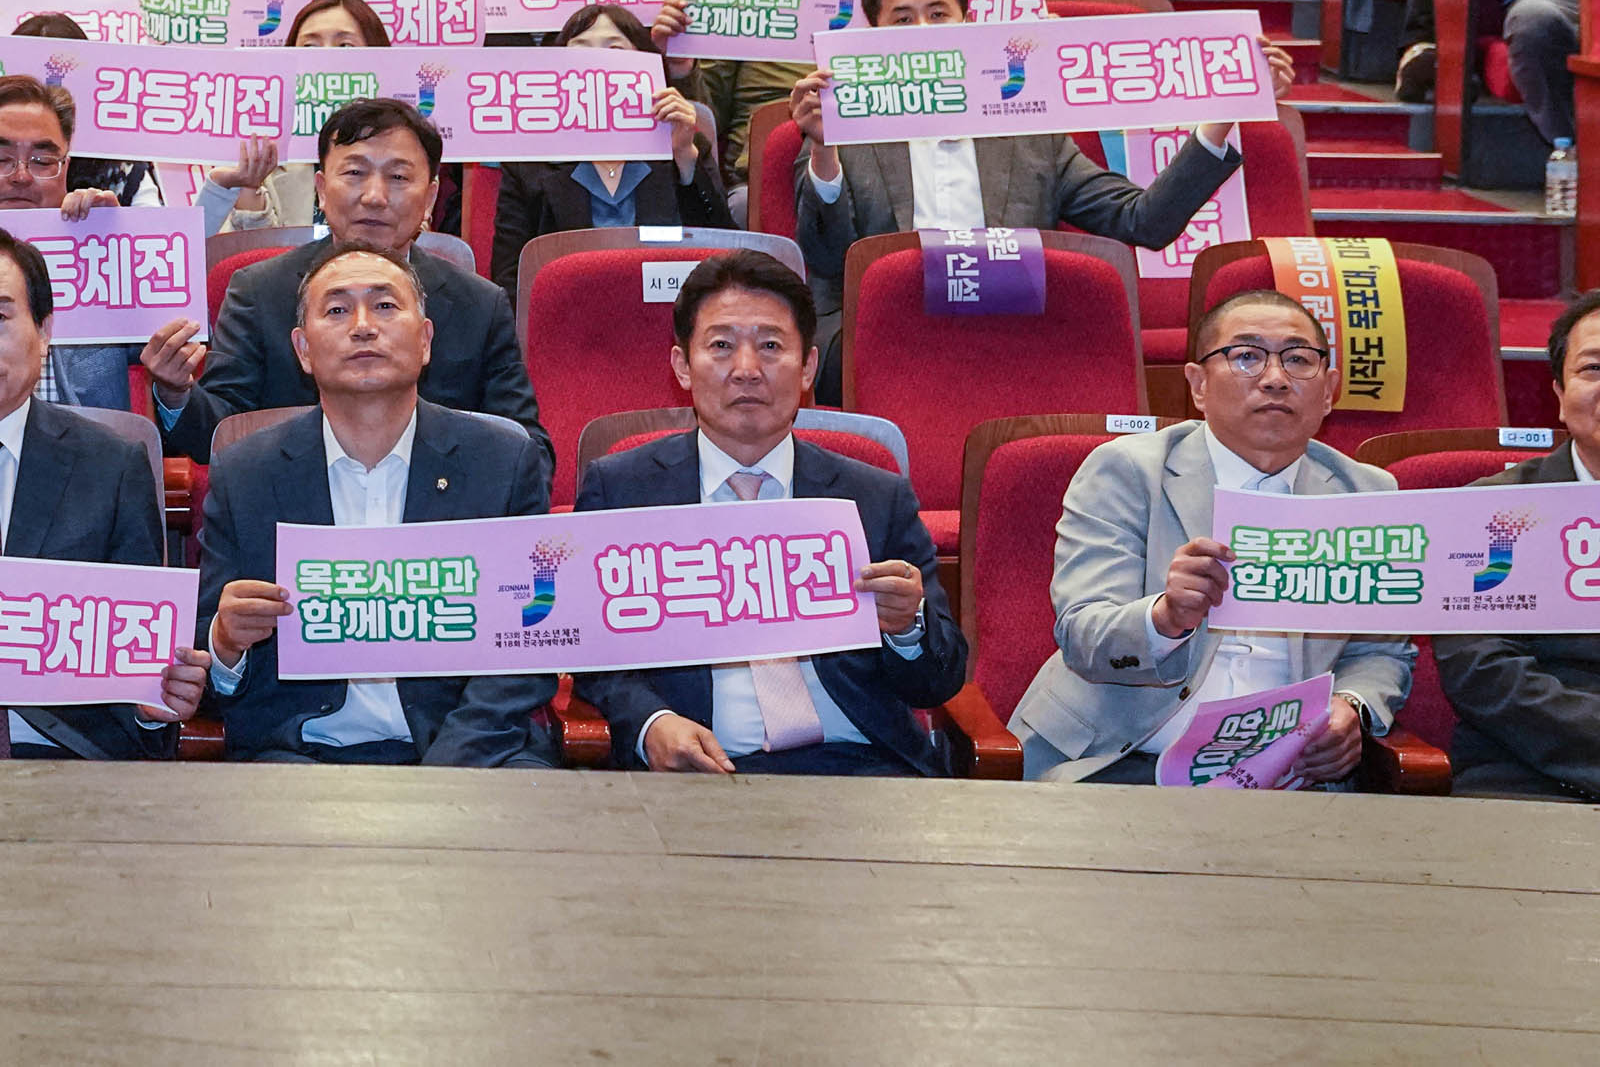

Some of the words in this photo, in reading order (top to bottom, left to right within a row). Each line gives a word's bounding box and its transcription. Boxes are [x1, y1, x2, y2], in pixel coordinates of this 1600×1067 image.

[683, 4, 798, 39] 함께하는
[295, 71, 379, 101] 시민과
[828, 50, 966, 84] 목포시민과
[1057, 34, 1260, 106] 감동체전
[93, 67, 285, 140] 감동체전
[467, 69, 657, 134] 감동체전
[835, 78, 967, 119] 함께하는
[649, 276, 681, 292] 시의
[946, 251, 980, 304] 신설
[1343, 263, 1383, 331] 목포대,
[1346, 335, 1385, 400] 시작도
[1113, 419, 1150, 430] 다-002
[1507, 432, 1547, 443] 다-001
[1230, 523, 1429, 565] 목포시민과
[1447, 552, 1485, 560] JEONNAM
[1465, 559, 1485, 567] 2024
[295, 556, 478, 599] 목포시민과
[497, 584, 530, 592] JEONNAM
[513, 592, 531, 600] 2024
[594, 530, 860, 634] 행복체전
[1231, 563, 1424, 605] 함께하는
[298, 596, 477, 644] 함께하는
[1190, 707, 1268, 785] 함께하
